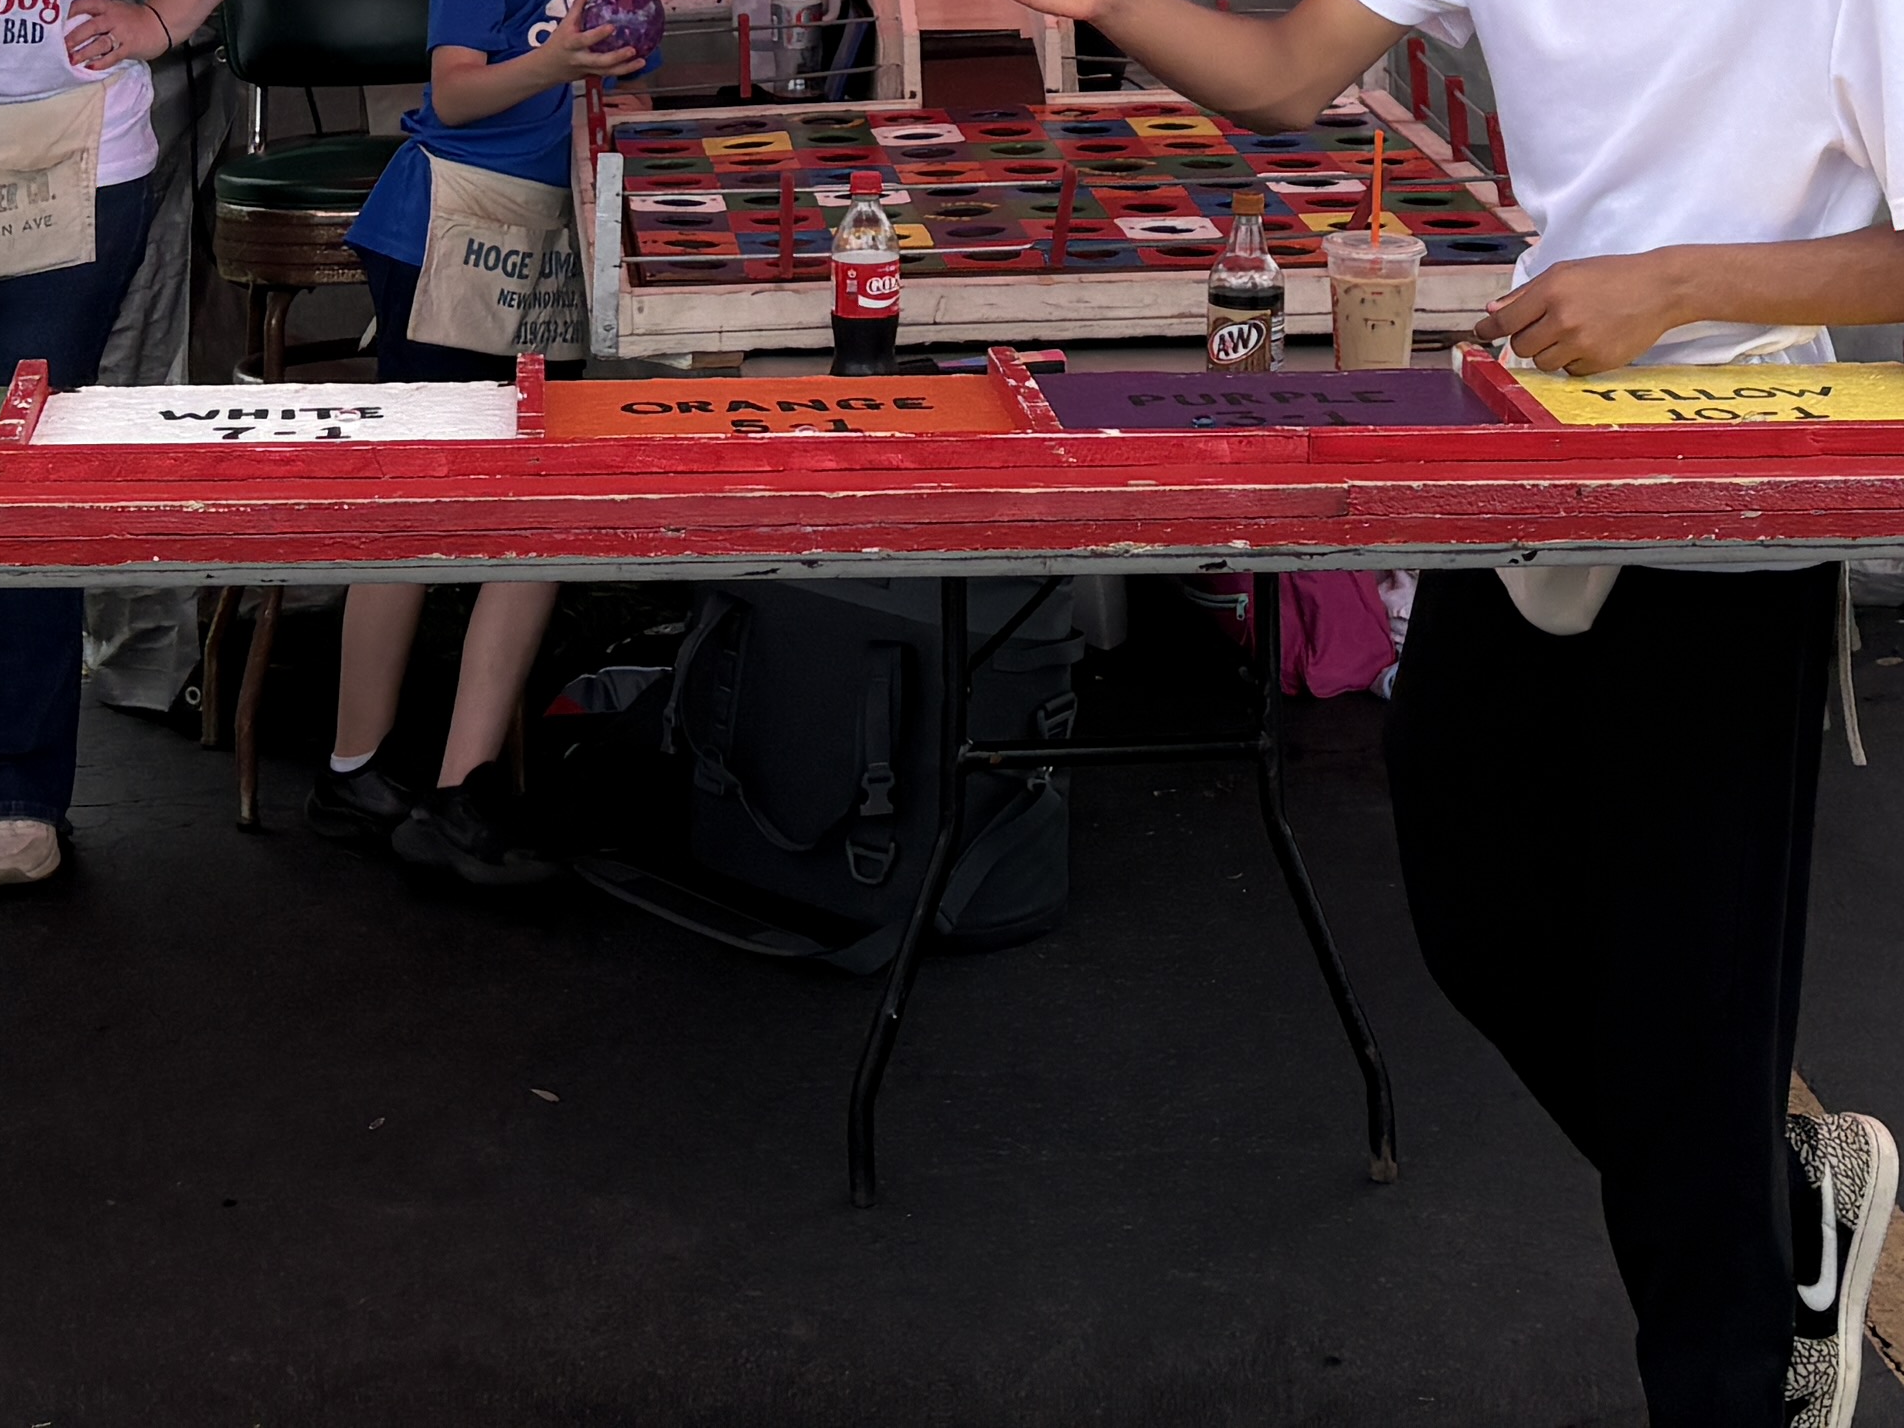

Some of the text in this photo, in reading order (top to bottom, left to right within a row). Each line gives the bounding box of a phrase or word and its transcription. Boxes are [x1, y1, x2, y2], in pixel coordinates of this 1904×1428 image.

[3, 19, 44, 44] BAD
[21, 214, 53, 232] AVE
[463, 238, 533, 280] HOGE
[1127, 390, 1395, 407] PURPLE
[1582, 386, 1834, 402] YELLOW
[158, 406, 385, 420] WHITE
[620, 397, 934, 415] ORANGE
